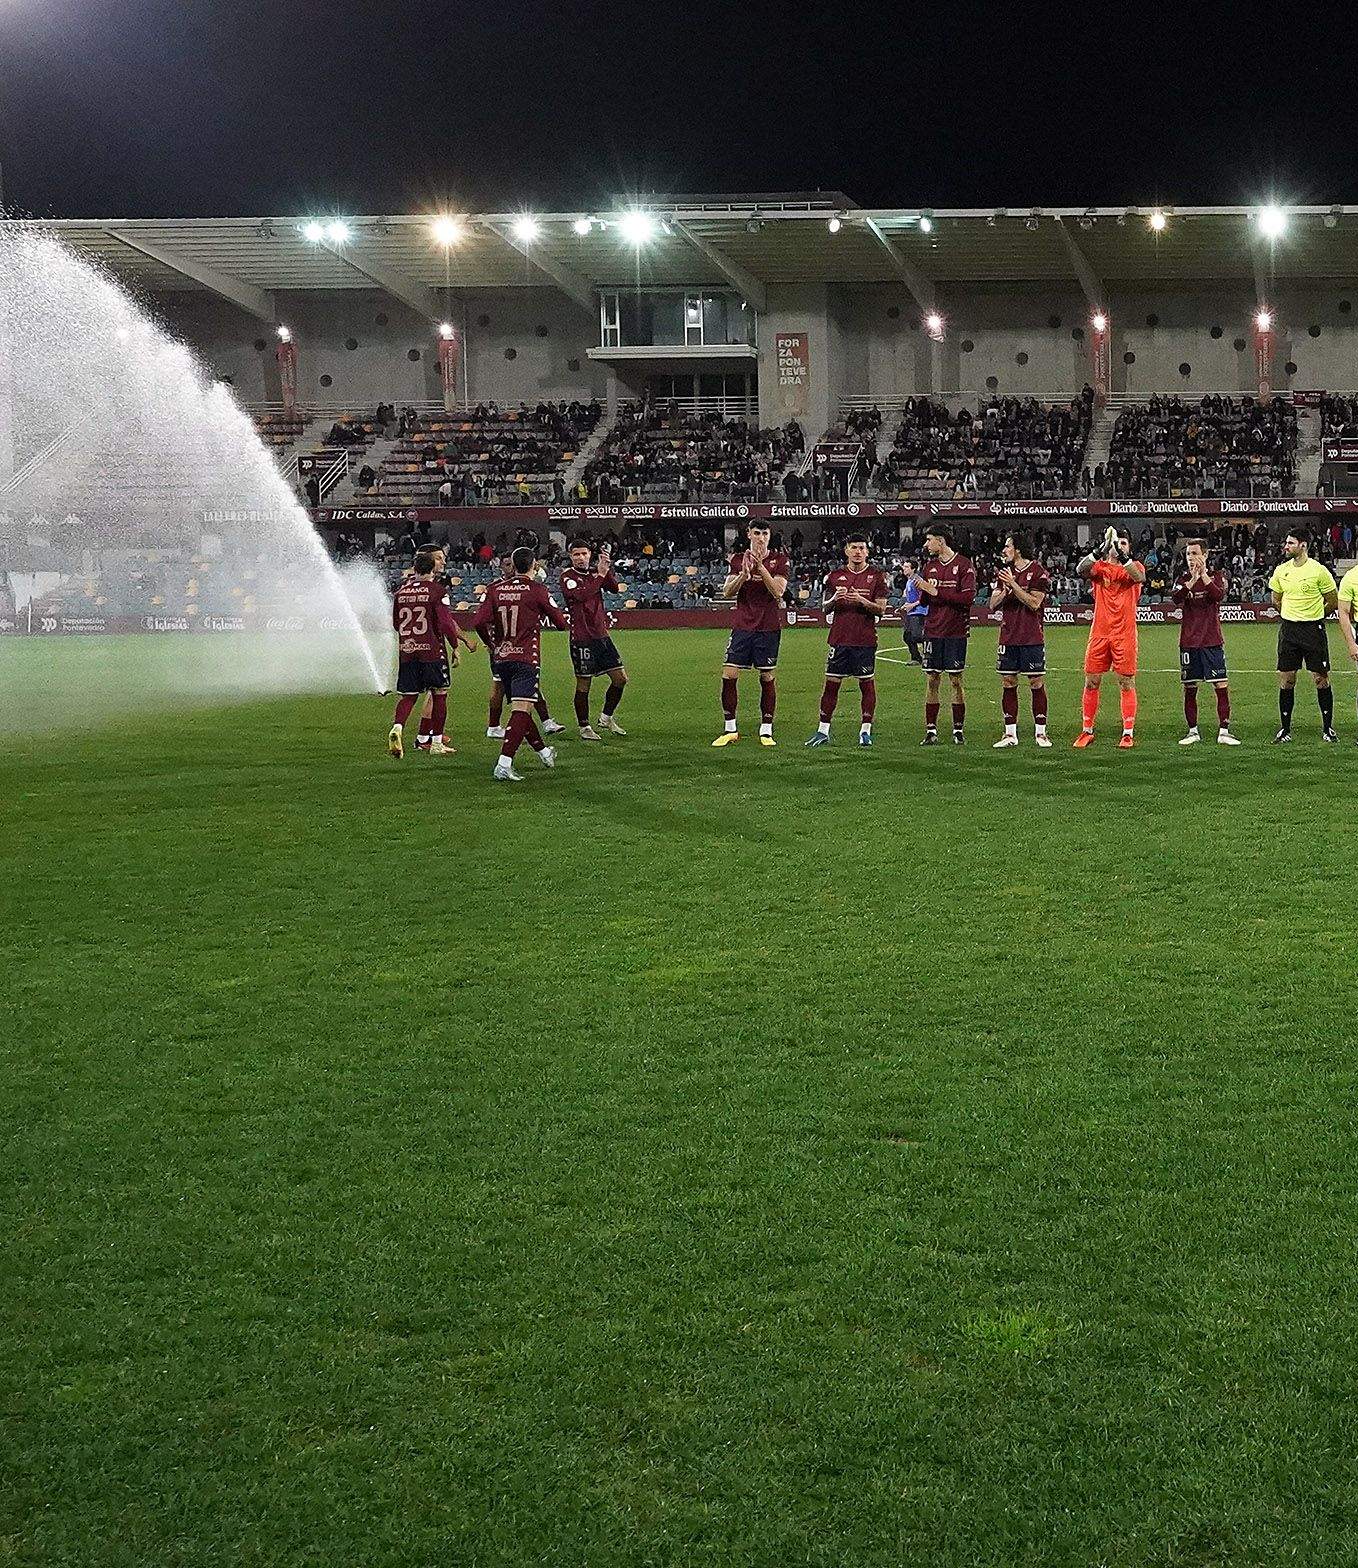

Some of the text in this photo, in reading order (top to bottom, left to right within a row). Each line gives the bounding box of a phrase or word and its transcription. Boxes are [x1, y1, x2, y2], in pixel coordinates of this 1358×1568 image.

[778, 339, 800, 347] FOR
[779, 349, 793, 357] ZA
[780, 358, 801, 366] PON
[780, 367, 806, 375] TEVE
[771, 504, 845, 516] Estrella Galicia
[1029, 506, 1058, 514] GALICIA
[1060, 506, 1087, 514] PALACE
[1110, 502, 1137, 512] Diario
[1147, 502, 1199, 512] Pontevedra
[1220, 501, 1248, 512] Diario
[1258, 501, 1309, 511] Pontevedra
[332, 510, 353, 519] IDC
[388, 510, 404, 519] S.A.
[548, 507, 581, 516] exalta
[585, 507, 618, 516] exalta
[622, 507, 655, 516] exalta
[661, 506, 735, 518] Estrella Galicia
[398, 606, 428, 636] 23
[498, 605, 519, 637] 11
[579, 648, 591, 659] 16
